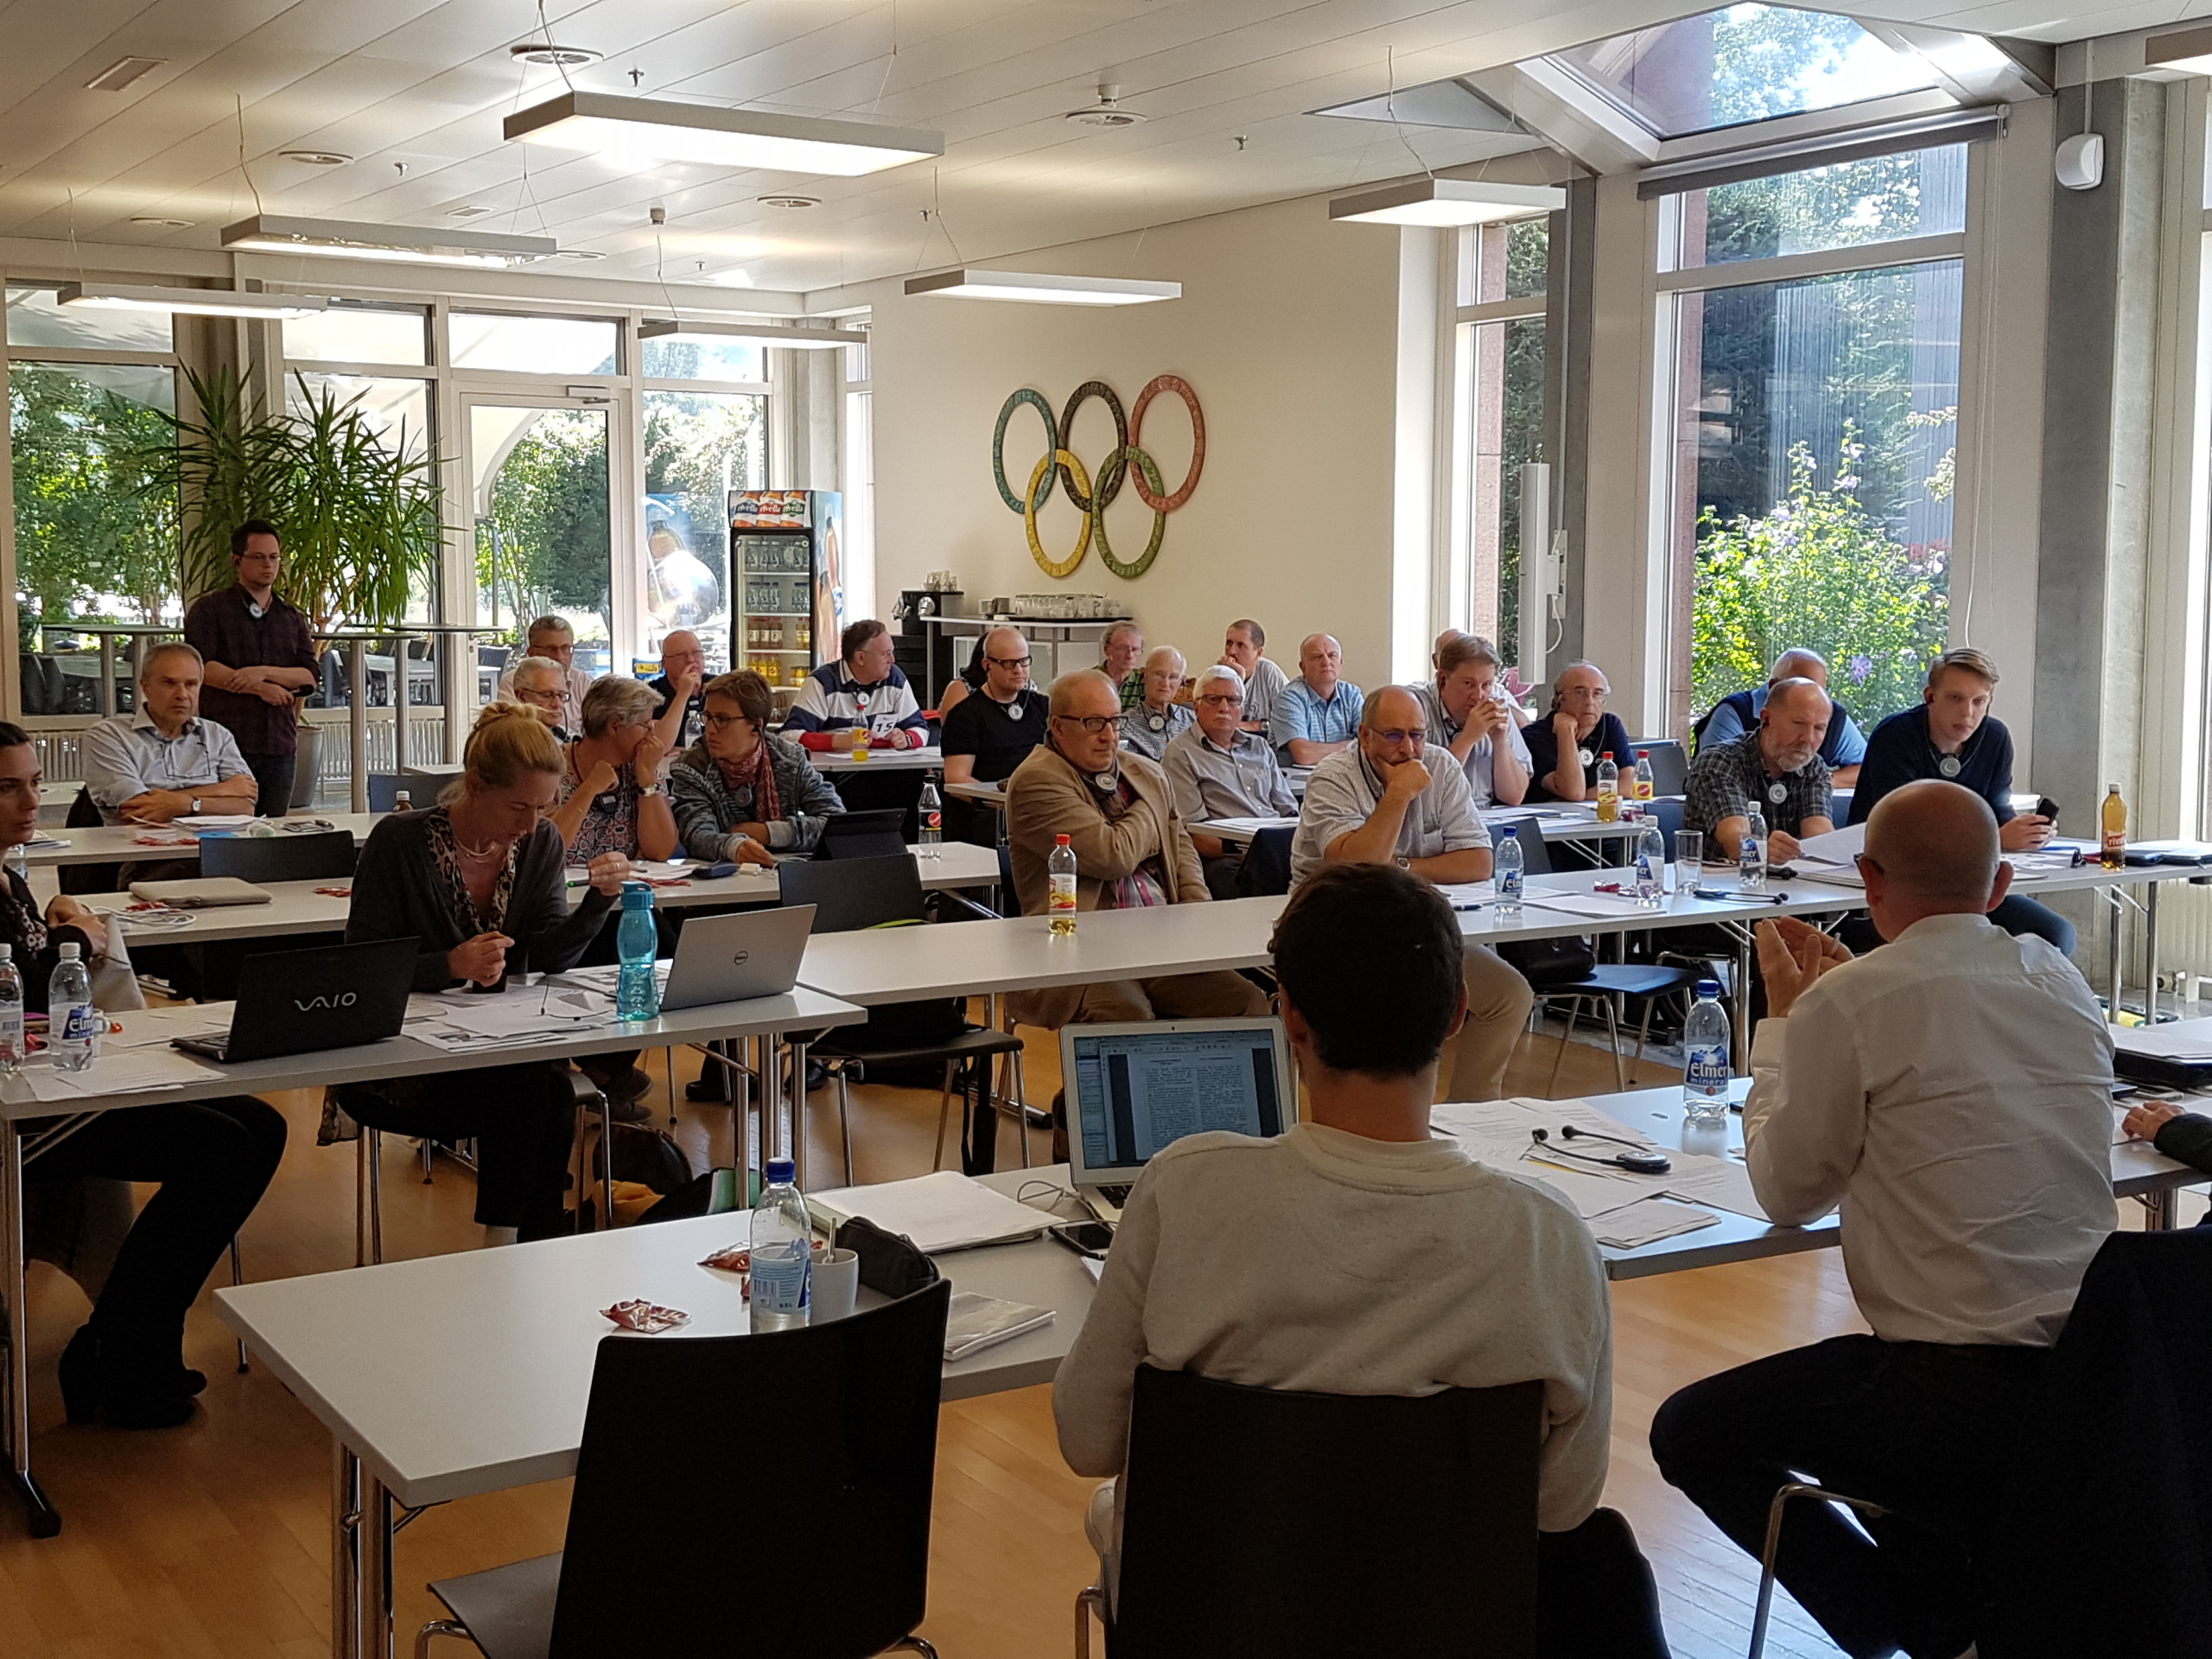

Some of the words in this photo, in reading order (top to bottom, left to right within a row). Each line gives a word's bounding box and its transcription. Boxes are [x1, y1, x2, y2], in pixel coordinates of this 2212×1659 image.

[876, 721, 895, 733] 15
[294, 992, 357, 1012] VAIO
[69, 1018, 93, 1033] Elm
[1690, 1062, 1727, 1077] Elmer
[1690, 1077, 1727, 1086] mineral
